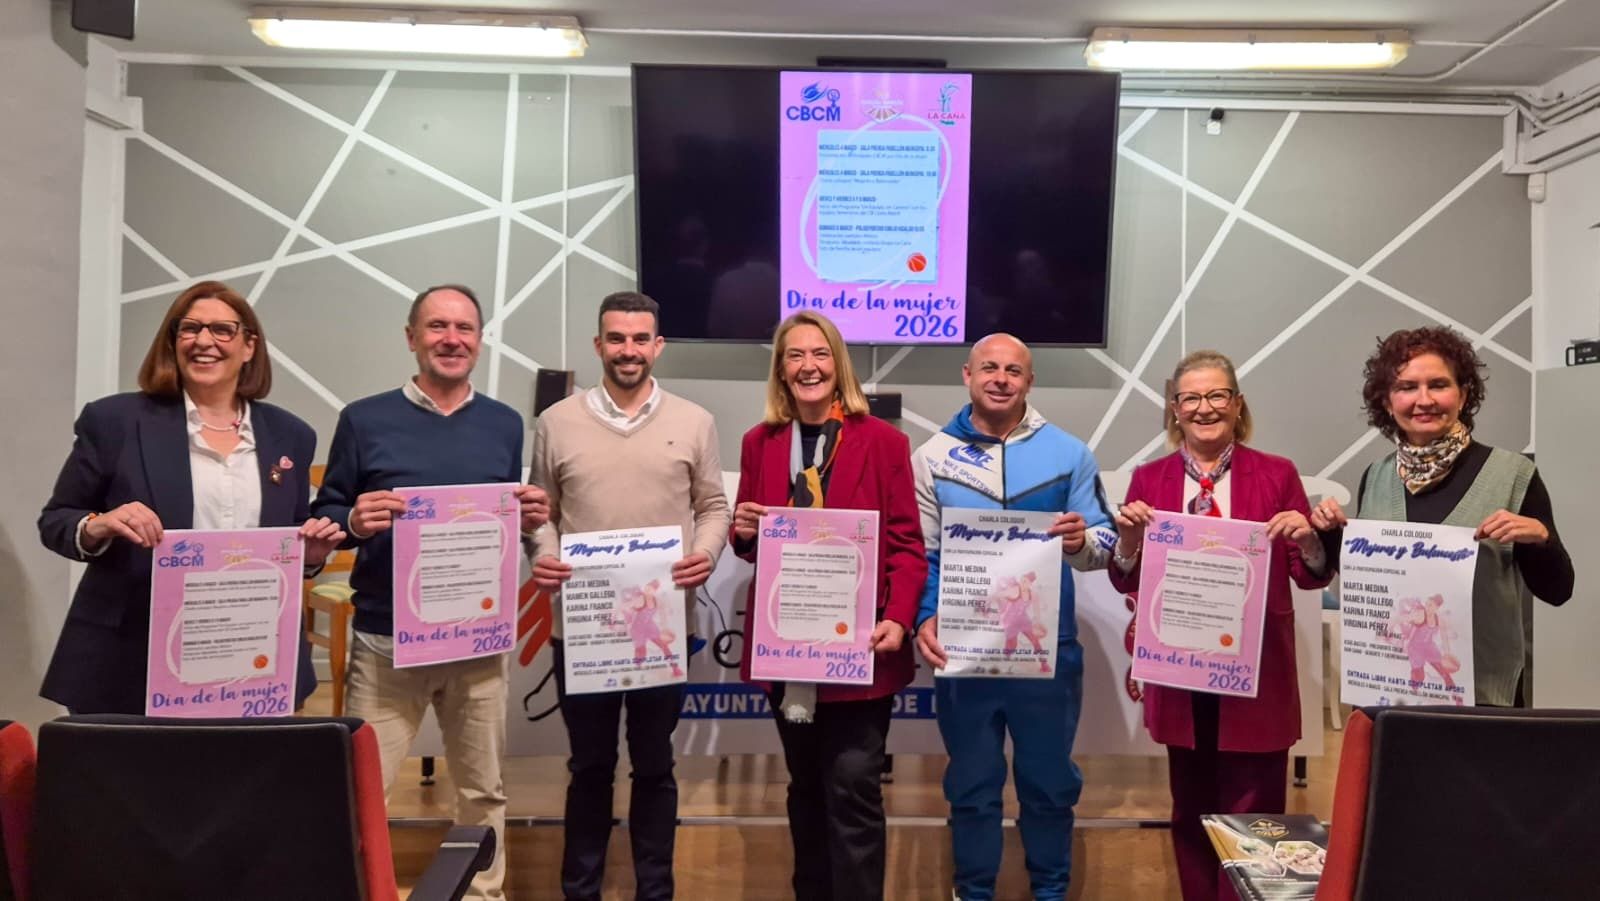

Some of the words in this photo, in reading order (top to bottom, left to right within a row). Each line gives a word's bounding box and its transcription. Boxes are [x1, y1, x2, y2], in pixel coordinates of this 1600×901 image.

[786, 105, 841, 121] CBCM
[831, 290, 862, 310] de
[866, 289, 889, 310] la
[893, 292, 960, 316] mujer
[894, 314, 959, 337] 2026
[763, 528, 797, 539] CBCM
[1148, 532, 1184, 545] CBCM
[1381, 528, 1403, 537] CHARLA
[158, 555, 204, 568] CBCM
[1343, 581, 1363, 591] MARTA
[1364, 583, 1389, 594] MEDINA
[1343, 594, 1365, 604] MAMEN
[1366, 596, 1394, 607] GALLEGO
[1343, 606, 1365, 616] KARINA
[1366, 608, 1390, 620] FRANCO
[430, 627, 449, 640] de
[454, 625, 468, 638] la
[471, 621, 511, 637] mujer
[1343, 618, 1368, 629] VIRGINIA
[1368, 620, 1389, 631] PÉREZ
[472, 633, 512, 653] 2026
[785, 644, 803, 658] de
[807, 645, 821, 659] la
[825, 647, 866, 664] mujer
[825, 662, 867, 679] 2026
[1166, 651, 1184, 665] de
[1190, 654, 1204, 668] la
[1208, 660, 1252, 675] mujer
[1207, 672, 1251, 692] 2026
[1346, 669, 1370, 680] ENTRADA
[1371, 674, 1387, 683] LIBRE
[191, 688, 214, 704] de
[220, 686, 238, 701] la
[242, 682, 288, 699] mujer
[242, 696, 288, 717] 2026
